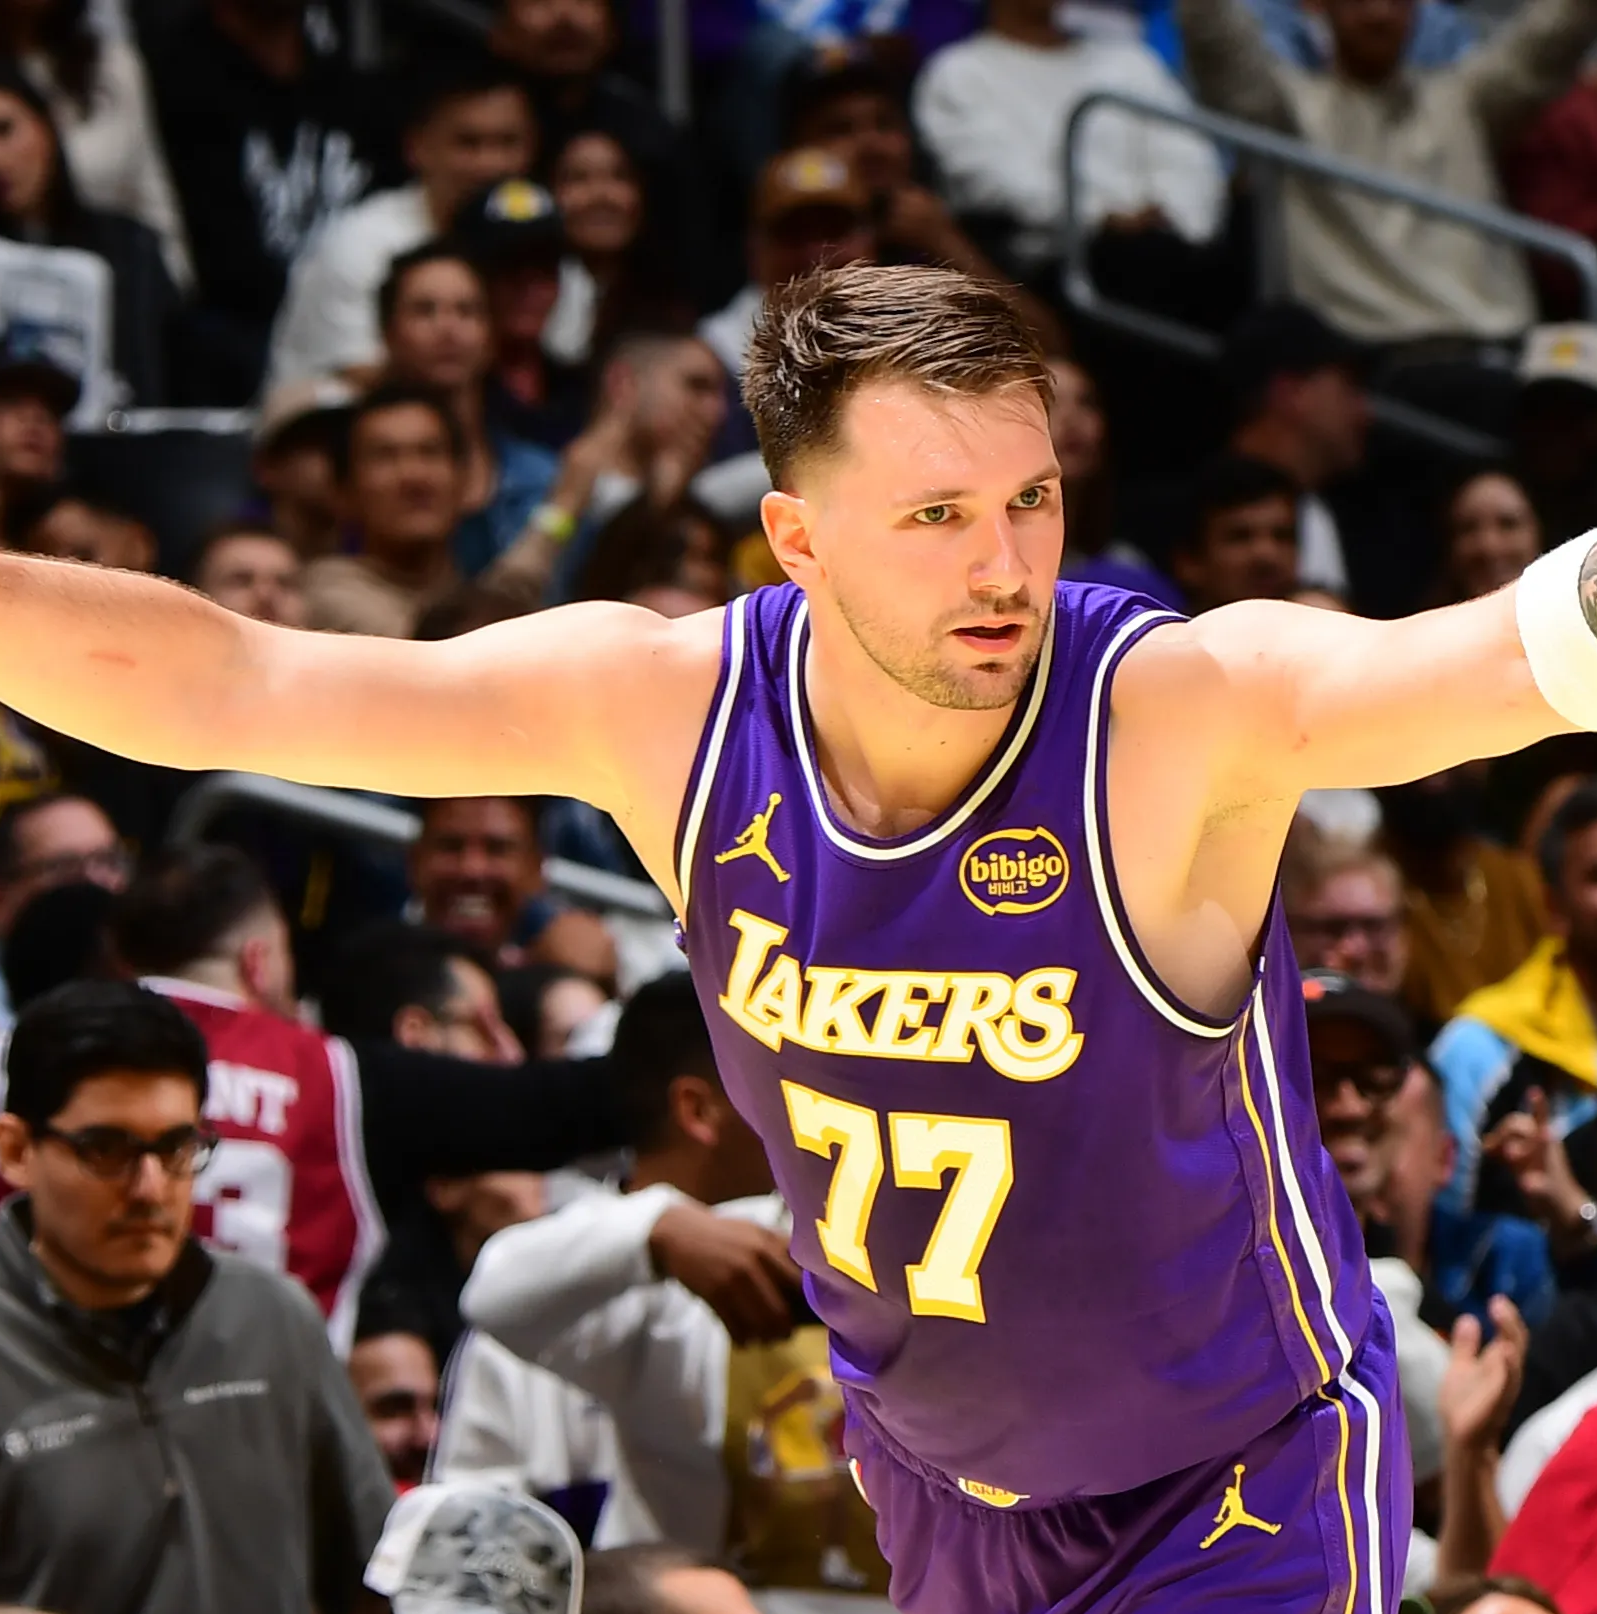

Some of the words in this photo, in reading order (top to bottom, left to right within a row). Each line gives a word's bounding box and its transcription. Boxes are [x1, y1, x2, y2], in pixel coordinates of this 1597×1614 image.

[969, 850, 1063, 888] bibigo
[987, 880, 1029, 897] 비비고
[718, 908, 1084, 1082] LAKERS
[780, 1079, 1014, 1324] 77
